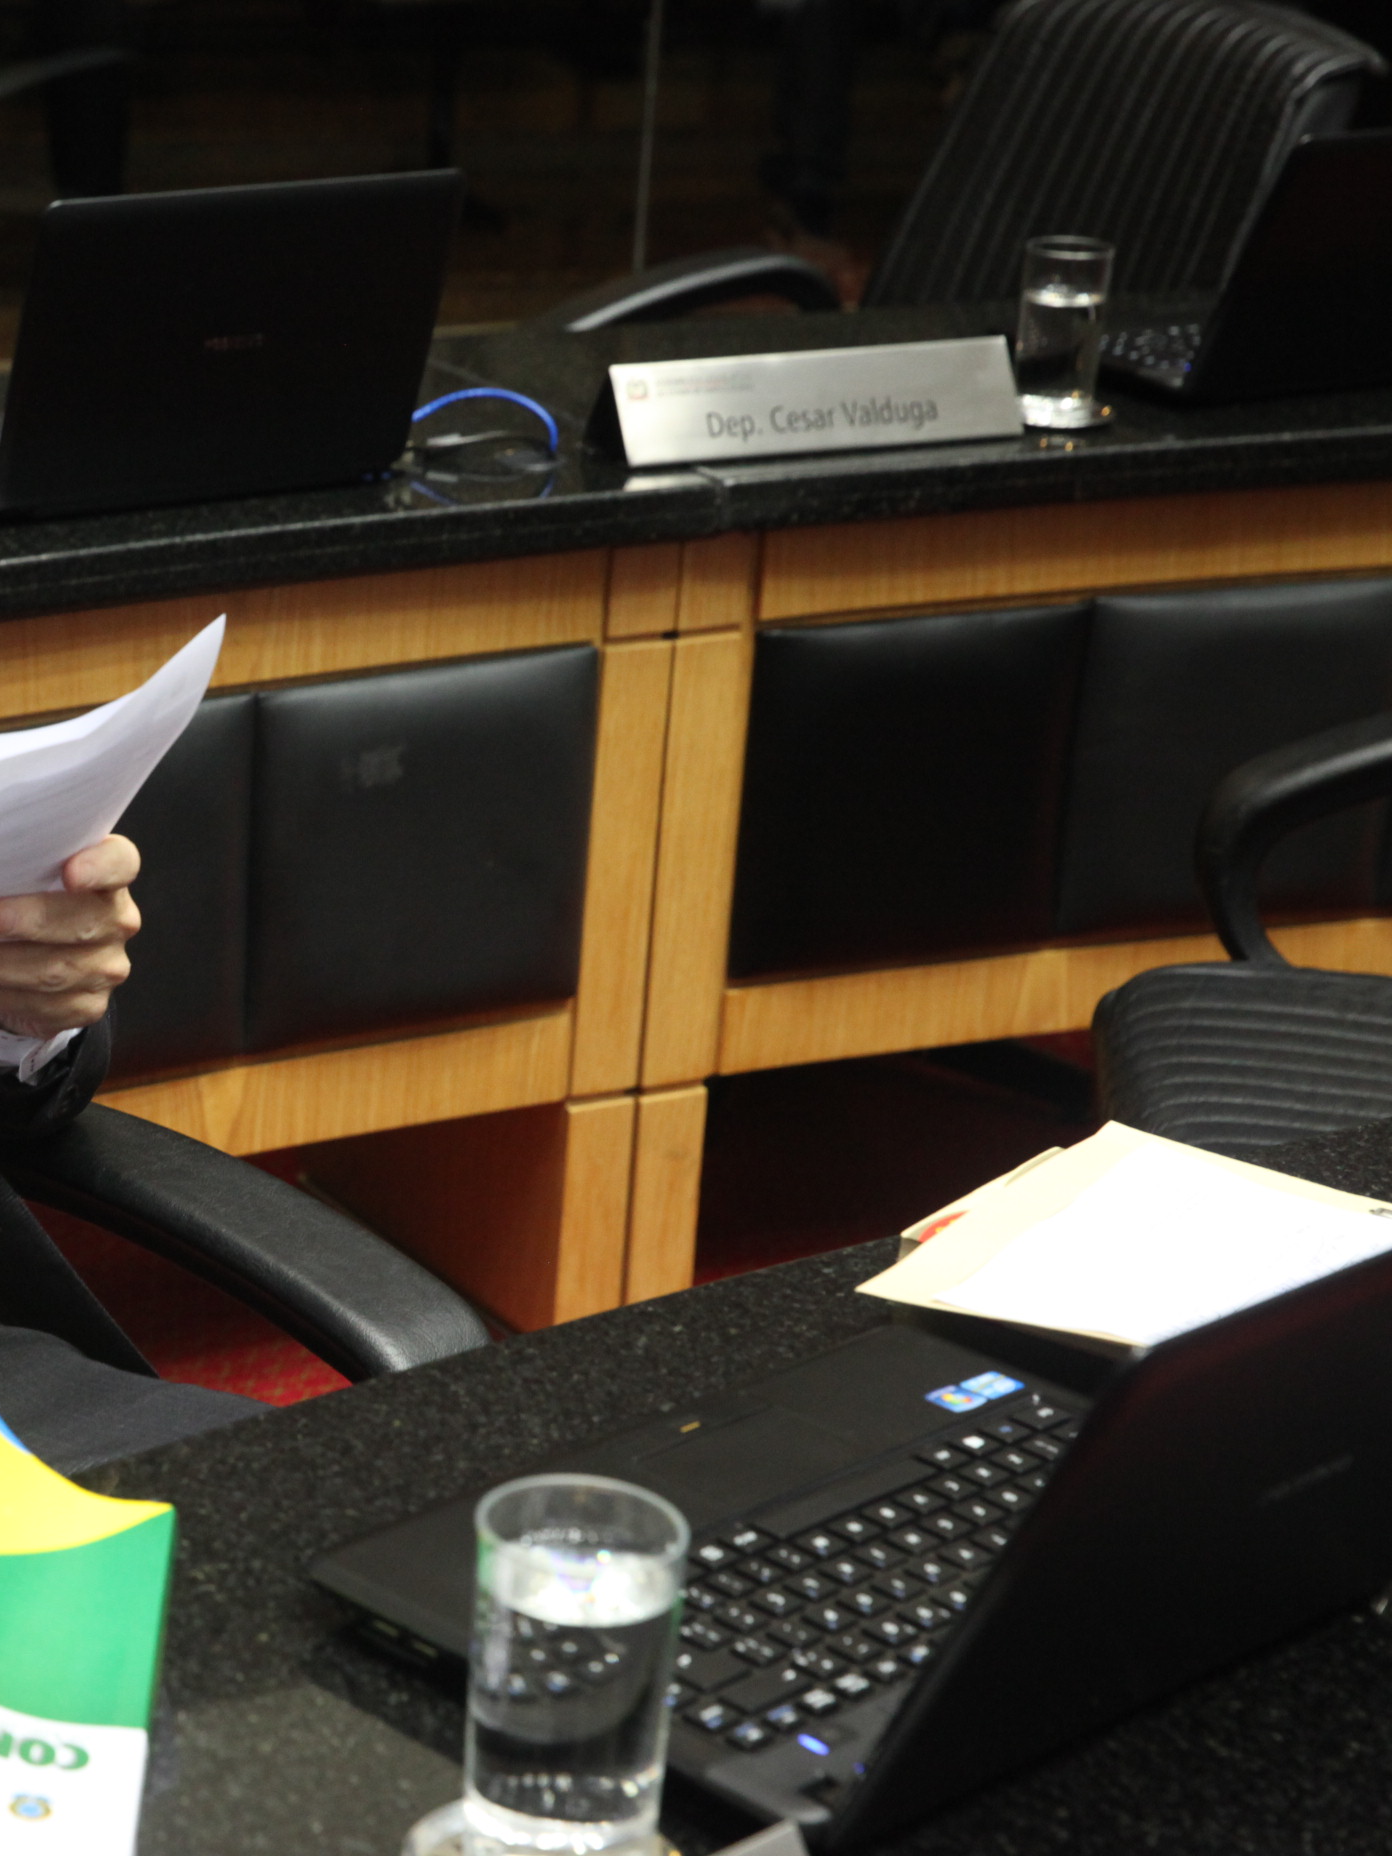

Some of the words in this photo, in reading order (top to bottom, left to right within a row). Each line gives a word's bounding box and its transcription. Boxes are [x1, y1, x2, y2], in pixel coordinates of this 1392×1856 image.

[707, 411, 763, 442] Dep.
[770, 404, 835, 433] Cesar
[839, 395, 938, 429] Valduga
